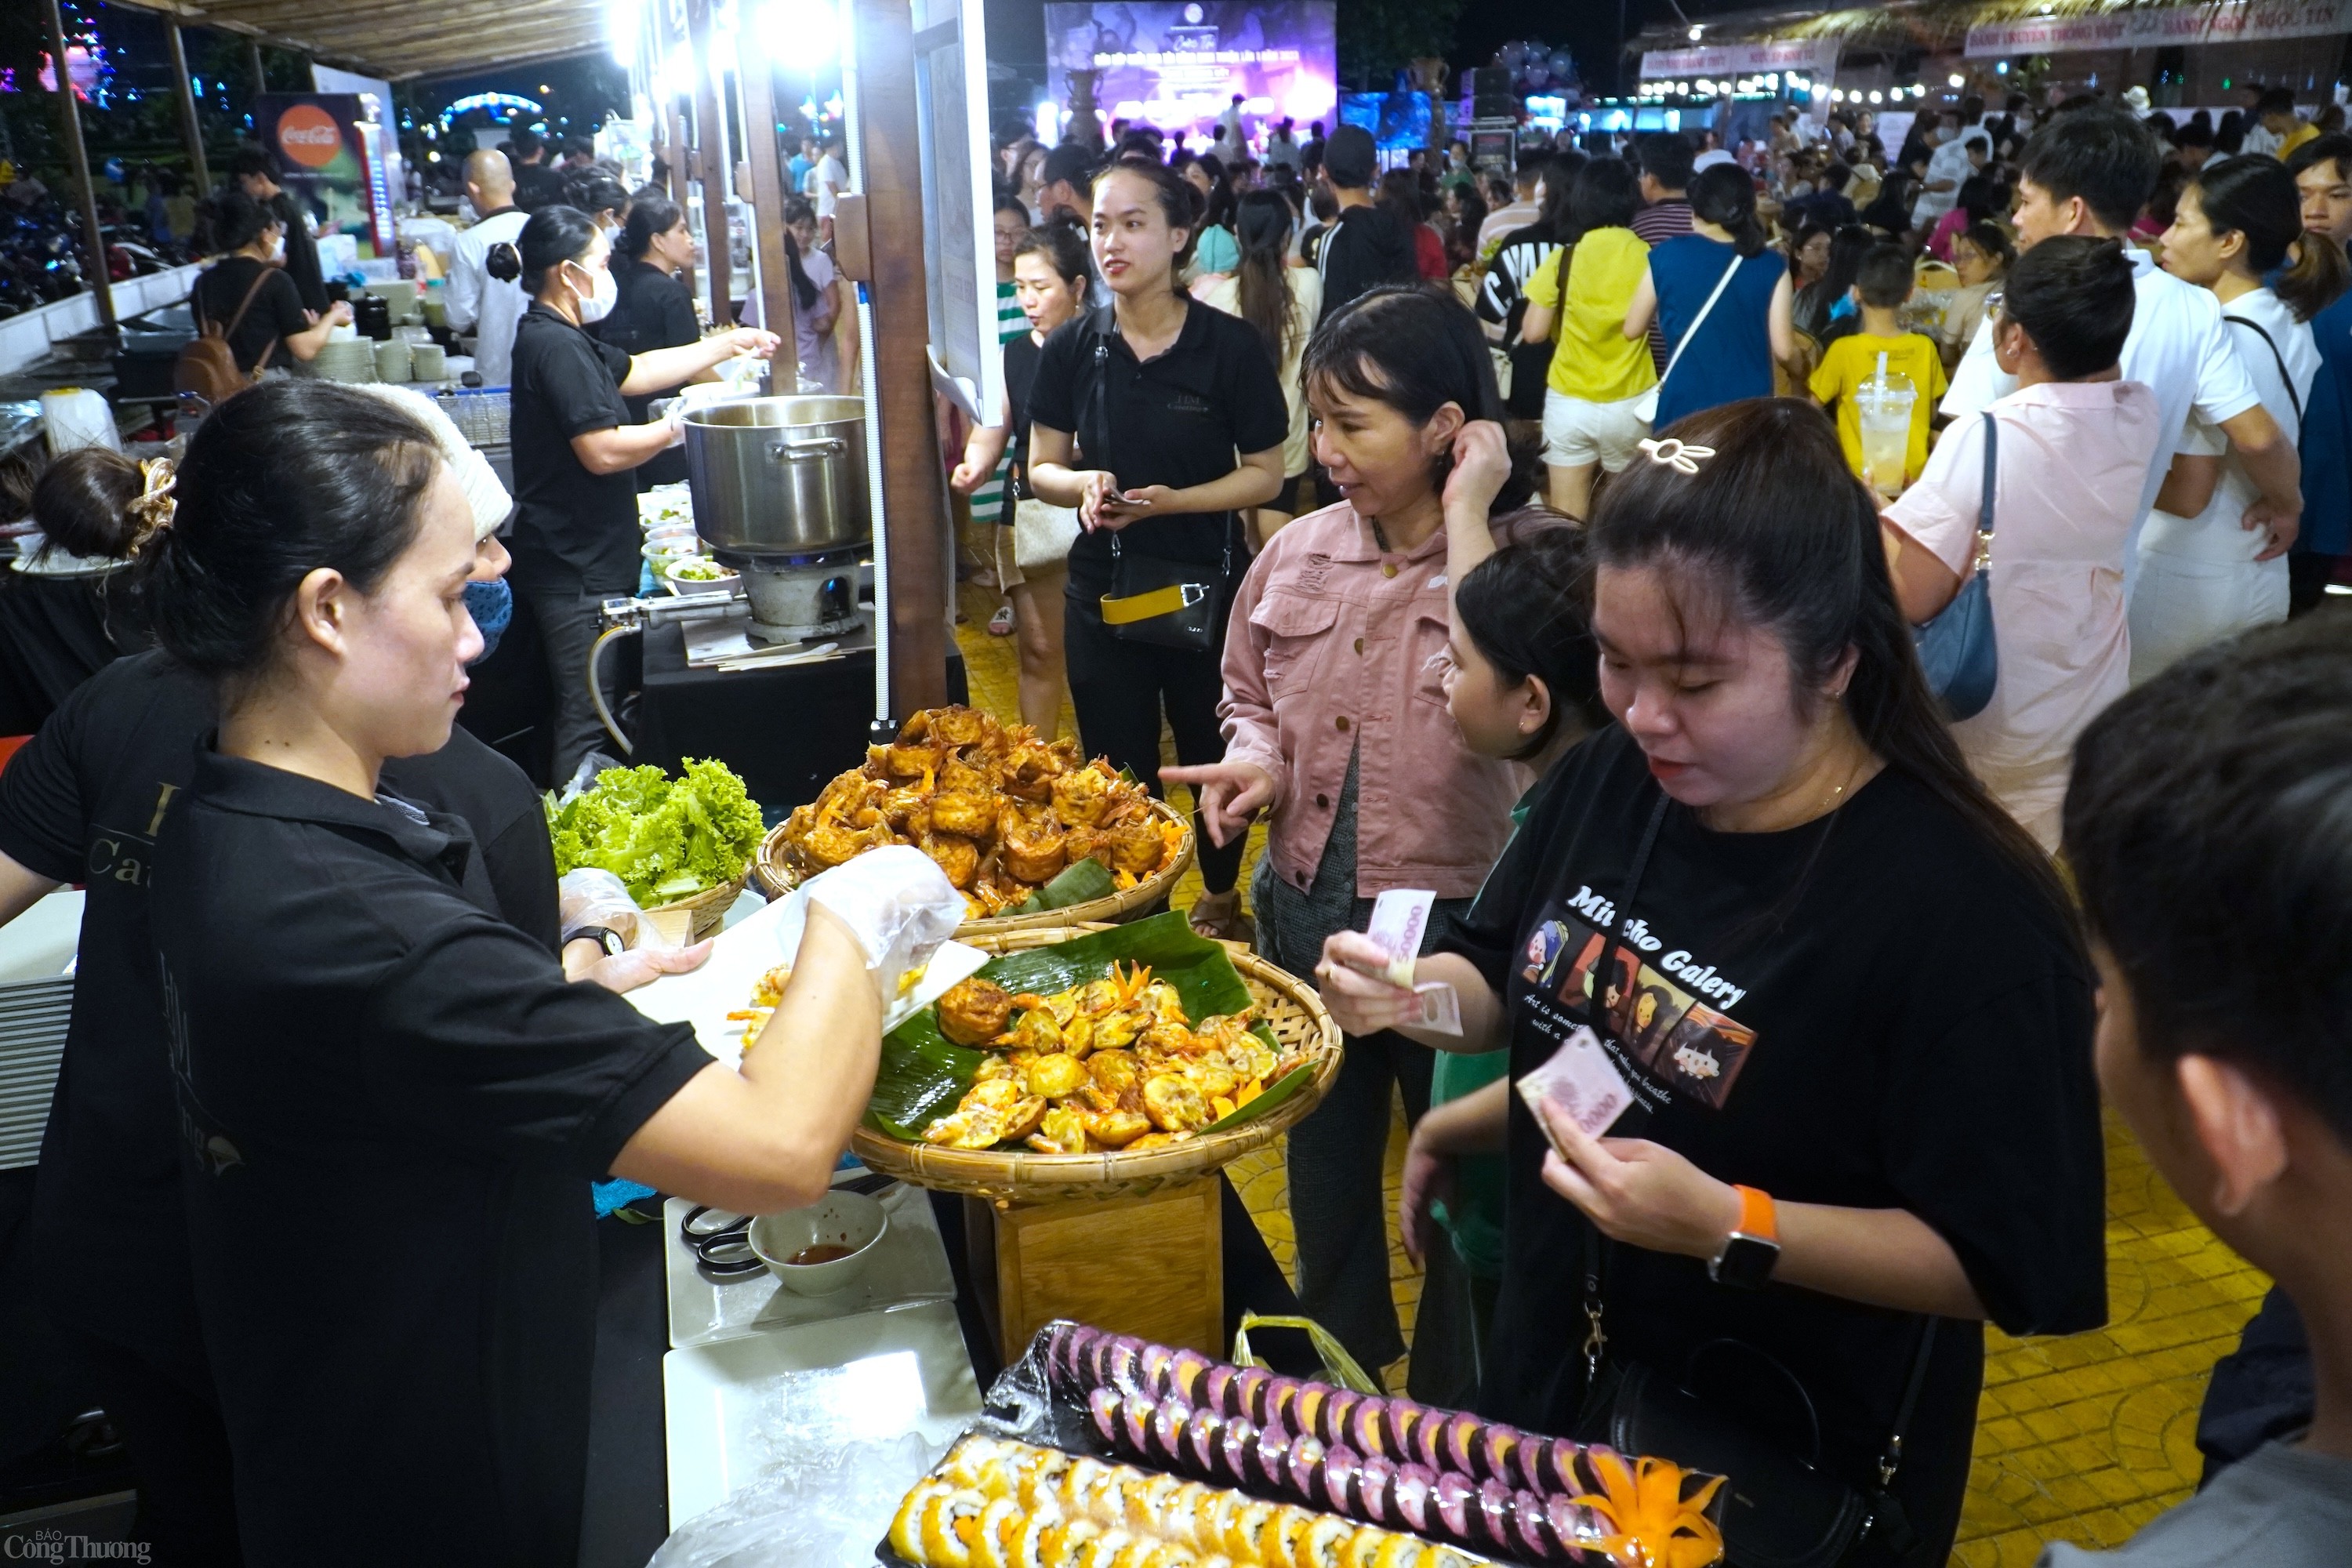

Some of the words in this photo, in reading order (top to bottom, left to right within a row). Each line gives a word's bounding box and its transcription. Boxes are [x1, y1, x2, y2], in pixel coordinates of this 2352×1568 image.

[1659, 949, 1748, 1011] Galery
[1523, 993, 1541, 1008] Art
[1541, 1004, 1551, 1015] is
[1552, 1012, 1584, 1031] somet
[1603, 1039, 1621, 1054] that
[1641, 1076, 1672, 1105] breathe
[1531, 1018, 1553, 1034] with
[1578, 1093, 1618, 1134] 0000
